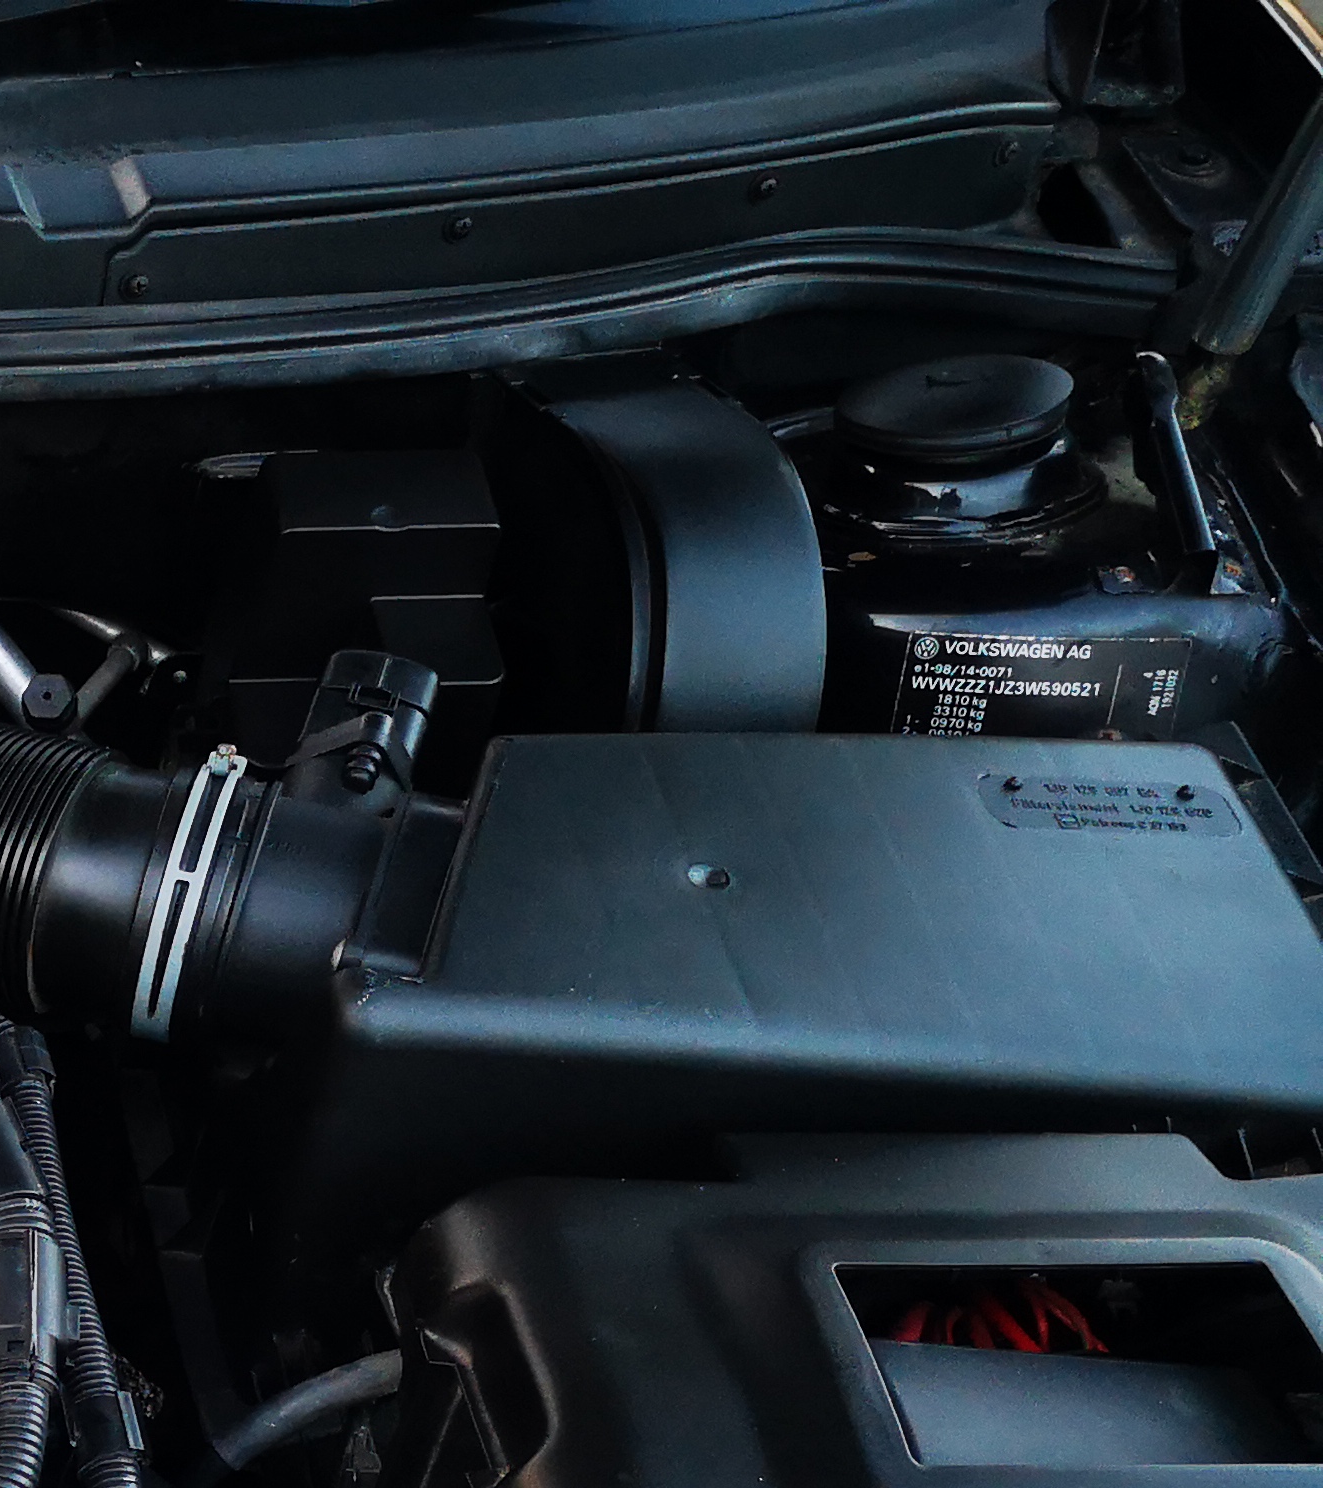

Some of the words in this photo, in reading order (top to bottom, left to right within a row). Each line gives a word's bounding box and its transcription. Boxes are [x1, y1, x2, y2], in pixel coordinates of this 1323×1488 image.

[945, 640, 1064, 659] VOLKSWAGEN
[1066, 645, 1092, 660] AG
[911, 675, 1101, 697] WVWZZZ1JZ3W590521
[938, 693, 970, 705] 1810
[972, 696, 988, 709] kg
[933, 705, 967, 717] 3310
[969, 707, 985, 720] kg
[930, 717, 965, 729] 0970
[967, 720, 983, 733] kg
